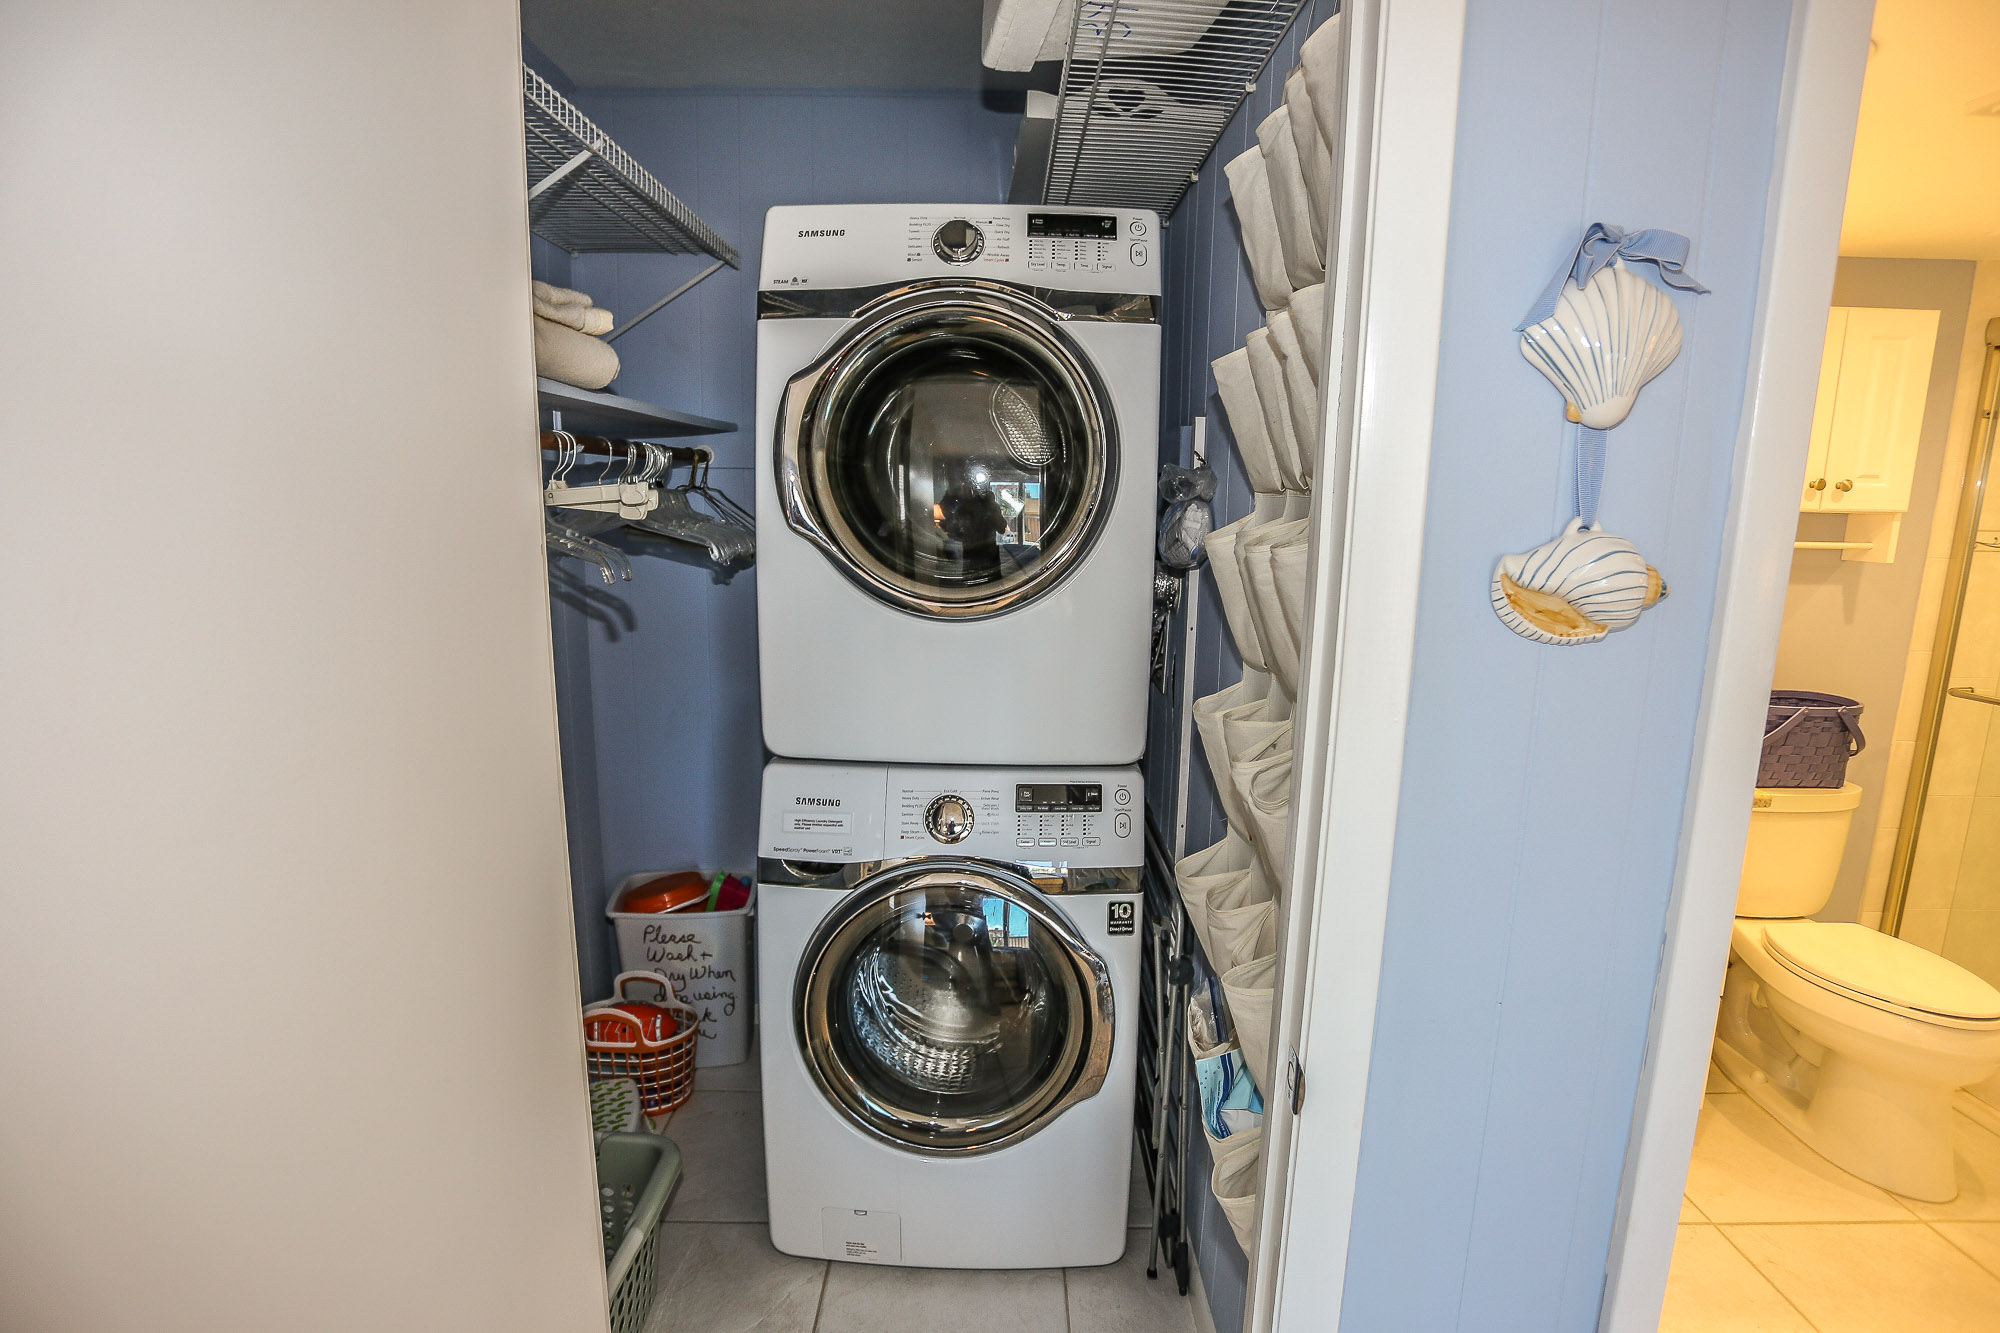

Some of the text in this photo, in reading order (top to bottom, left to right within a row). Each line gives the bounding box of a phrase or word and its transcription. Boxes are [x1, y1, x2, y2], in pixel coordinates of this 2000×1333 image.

[798, 229, 846, 238] SAMSUNG
[795, 797, 841, 807] SAMSUNG
[1111, 903, 1132, 918] 10
[642, 924, 702, 944] Please
[646, 944, 698, 963] Wash
[689, 965, 737, 983] When
[692, 986, 738, 1017] using
